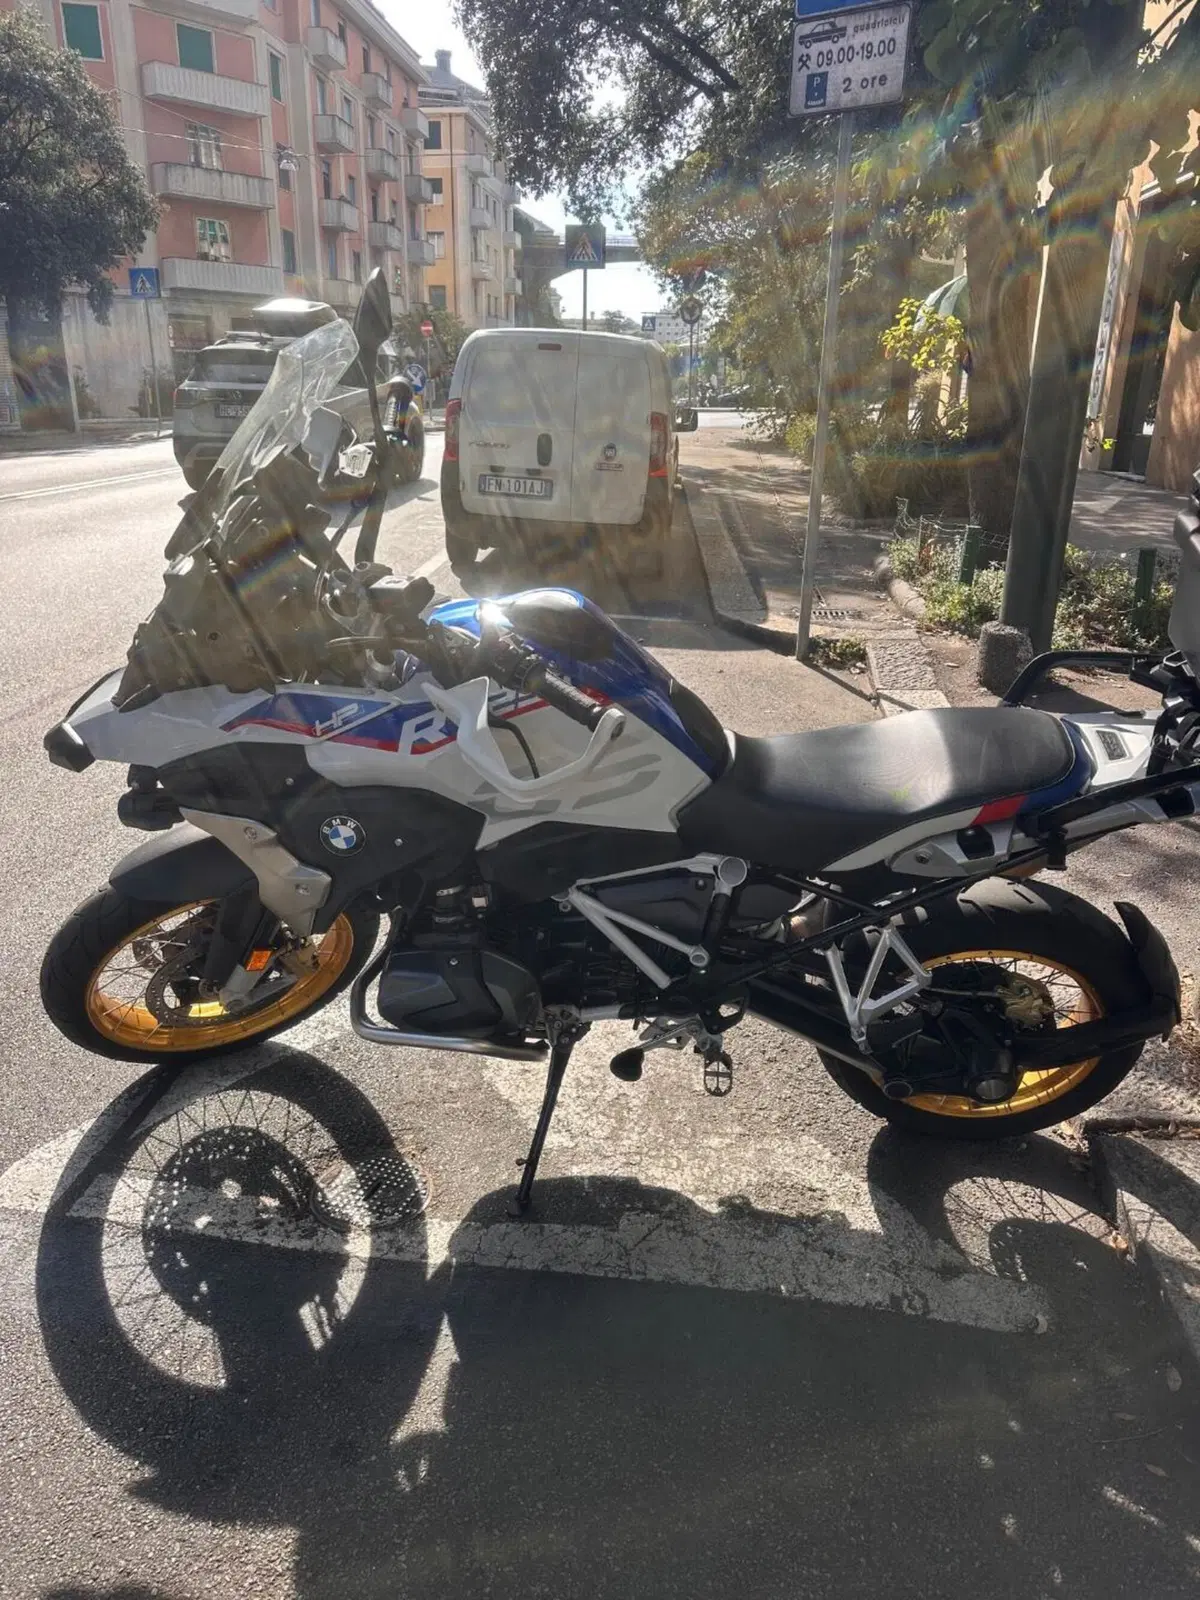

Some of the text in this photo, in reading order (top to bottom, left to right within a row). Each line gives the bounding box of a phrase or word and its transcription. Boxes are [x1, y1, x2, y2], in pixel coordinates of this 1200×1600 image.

[842, 74, 888, 93] 2 ore
[315, 703, 359, 736] HP
[322, 818, 357, 834] BMW
